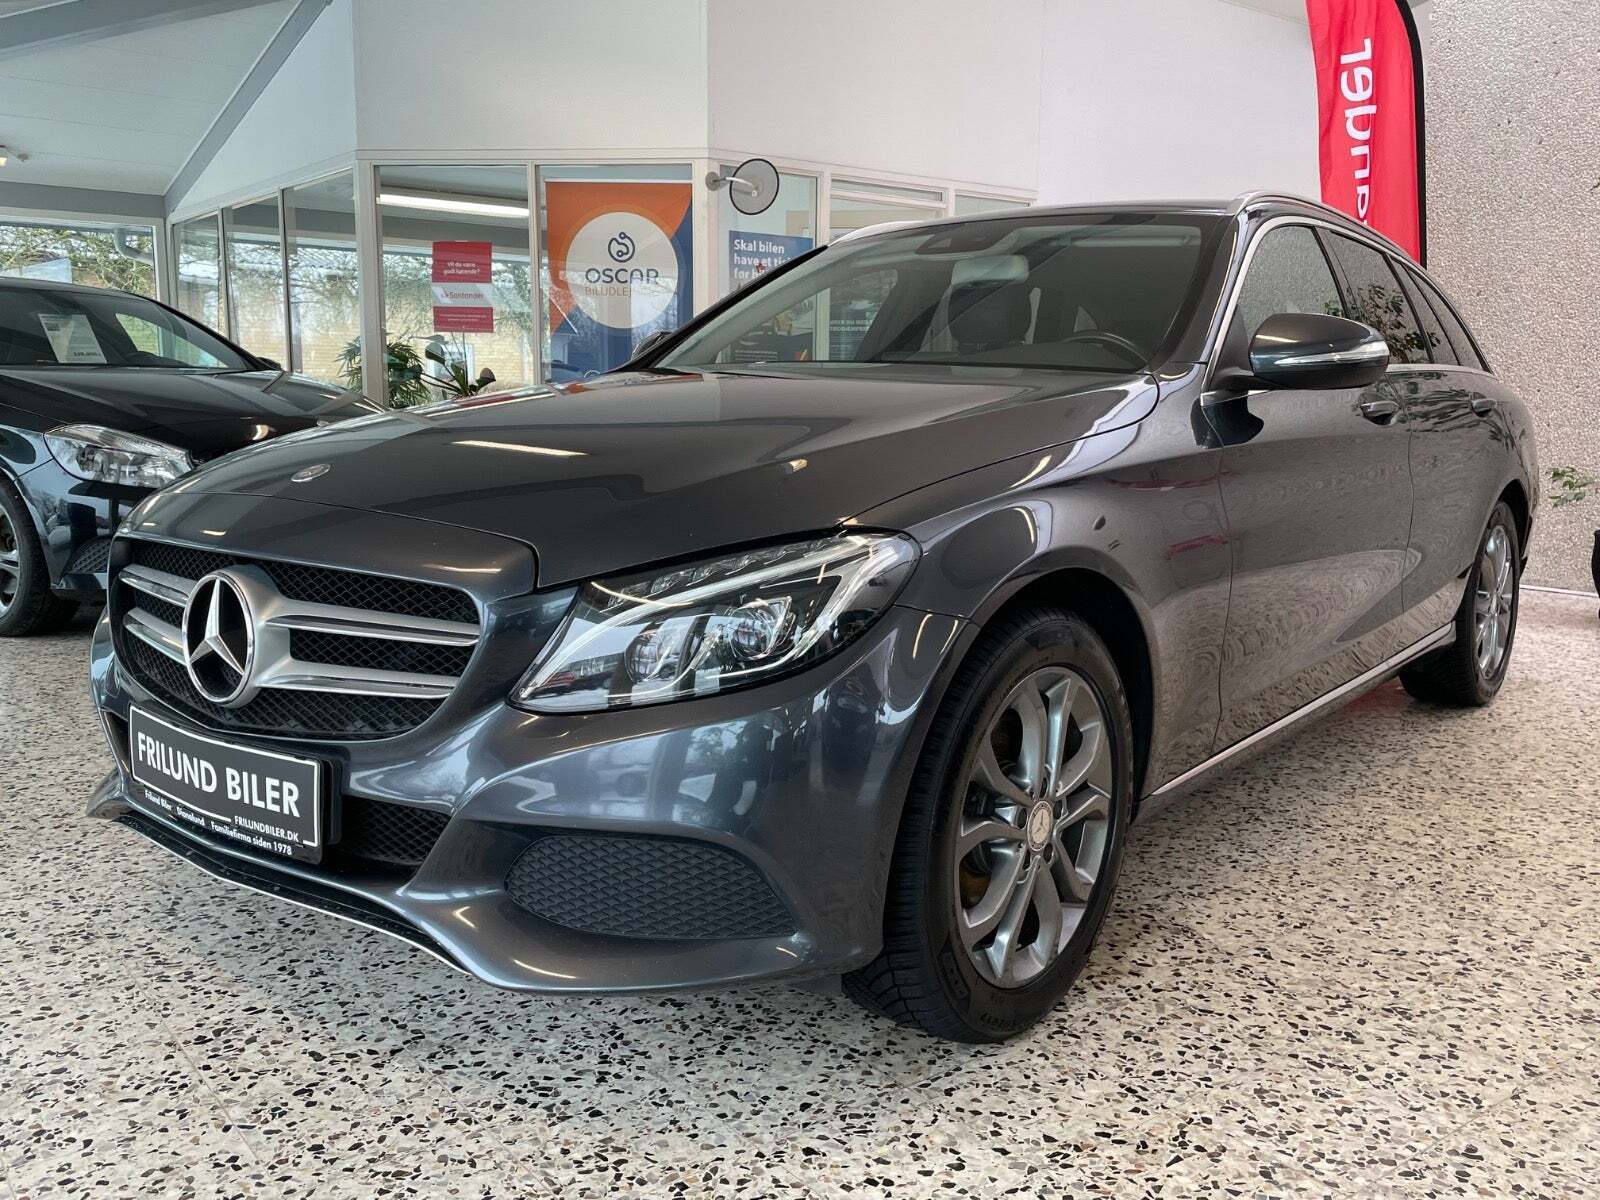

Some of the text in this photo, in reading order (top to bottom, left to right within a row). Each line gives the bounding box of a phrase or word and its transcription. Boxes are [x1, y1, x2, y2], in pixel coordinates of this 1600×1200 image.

[733, 239, 785, 254] Skal bilen
[733, 253, 760, 266] have
[585, 268, 659, 285] OSCAR
[734, 267, 750, 279] for
[137, 731, 300, 818] FRILUND BILER
[234, 815, 299, 843] FRILUNDBILER.DK
[211, 821, 252, 843] Familiefirma
[252, 837, 272, 851] siden
[273, 841, 293, 856] 1978
